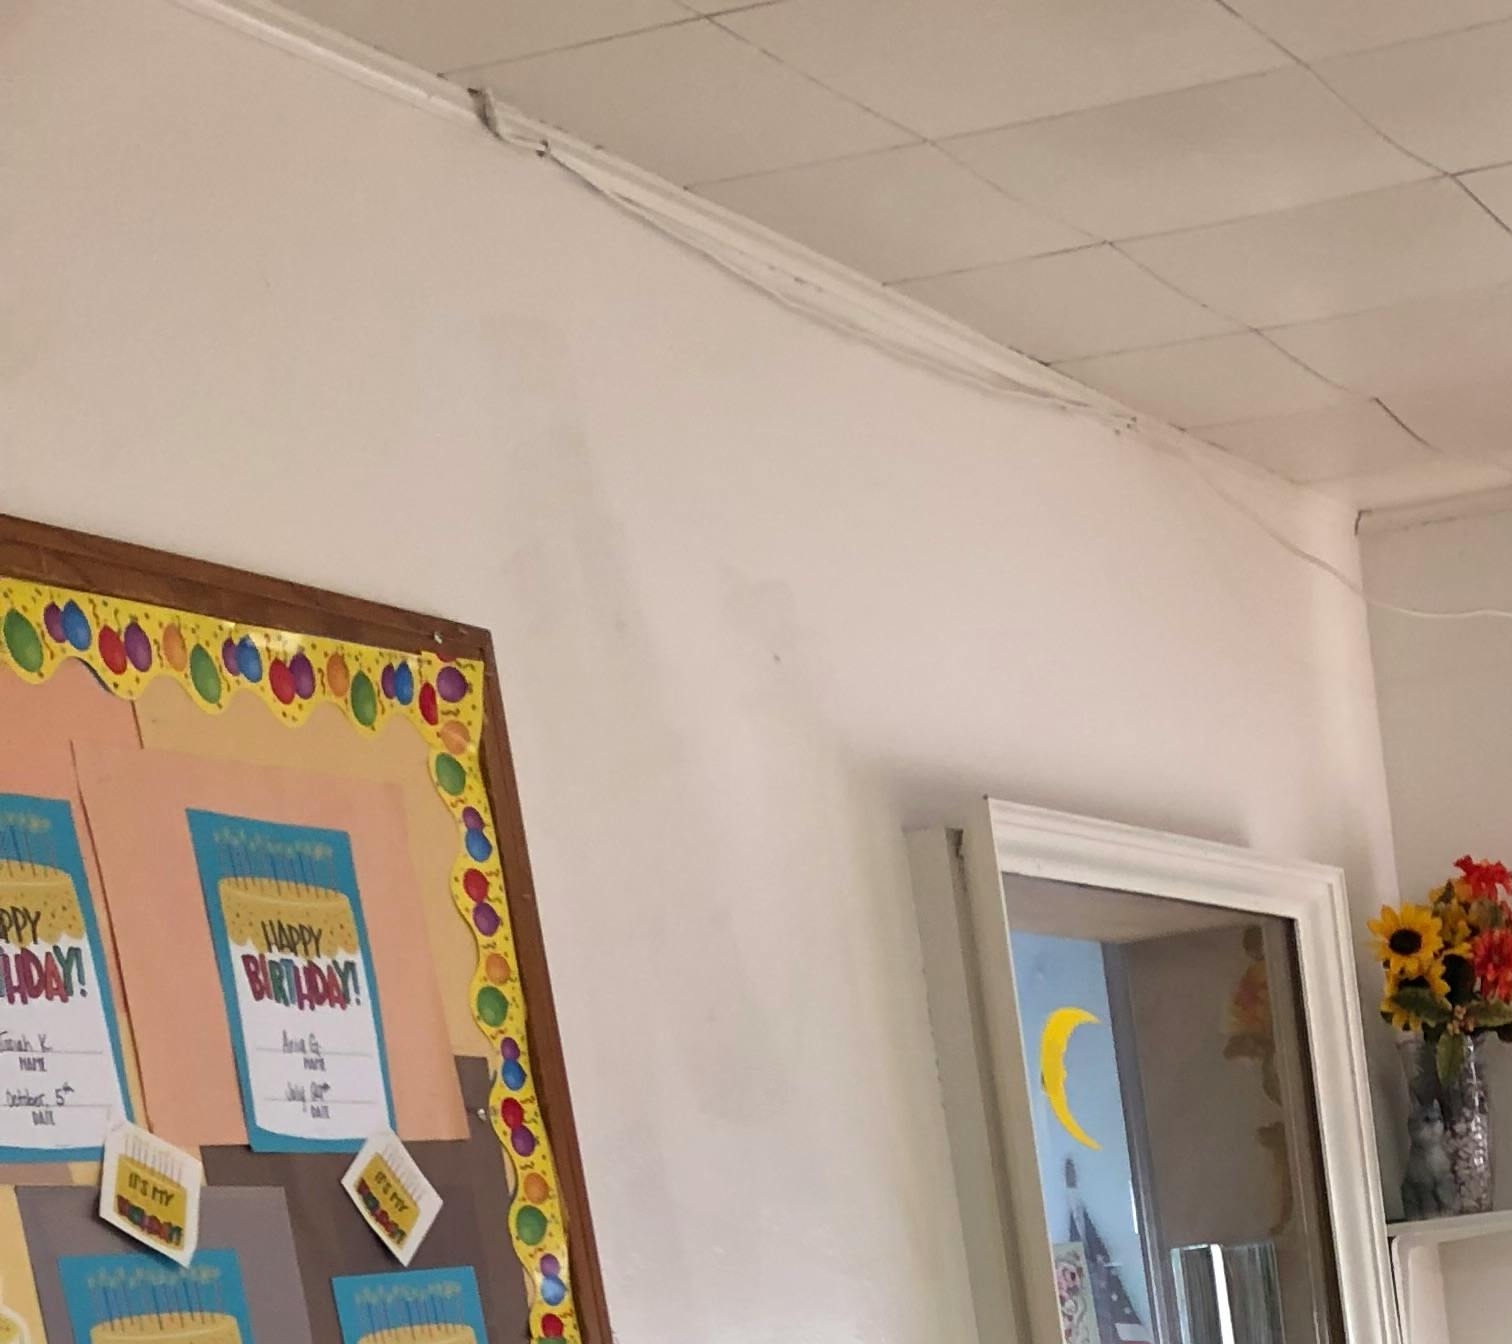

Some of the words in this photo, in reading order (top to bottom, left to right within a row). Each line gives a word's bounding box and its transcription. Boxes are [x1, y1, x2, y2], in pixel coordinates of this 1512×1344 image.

[0, 905, 41, 944] PPY
[261, 919, 322, 957] HAPPY
[0, 945, 87, 1004] HDAY!
[241, 953, 361, 1011] BIRTHDAY!
[19, 1056, 47, 1072] NAME
[303, 1057, 326, 1072] NAME
[128, 1171, 148, 1197] IT'S
[151, 1185, 176, 1207] MY
[390, 1192, 409, 1212] MY
